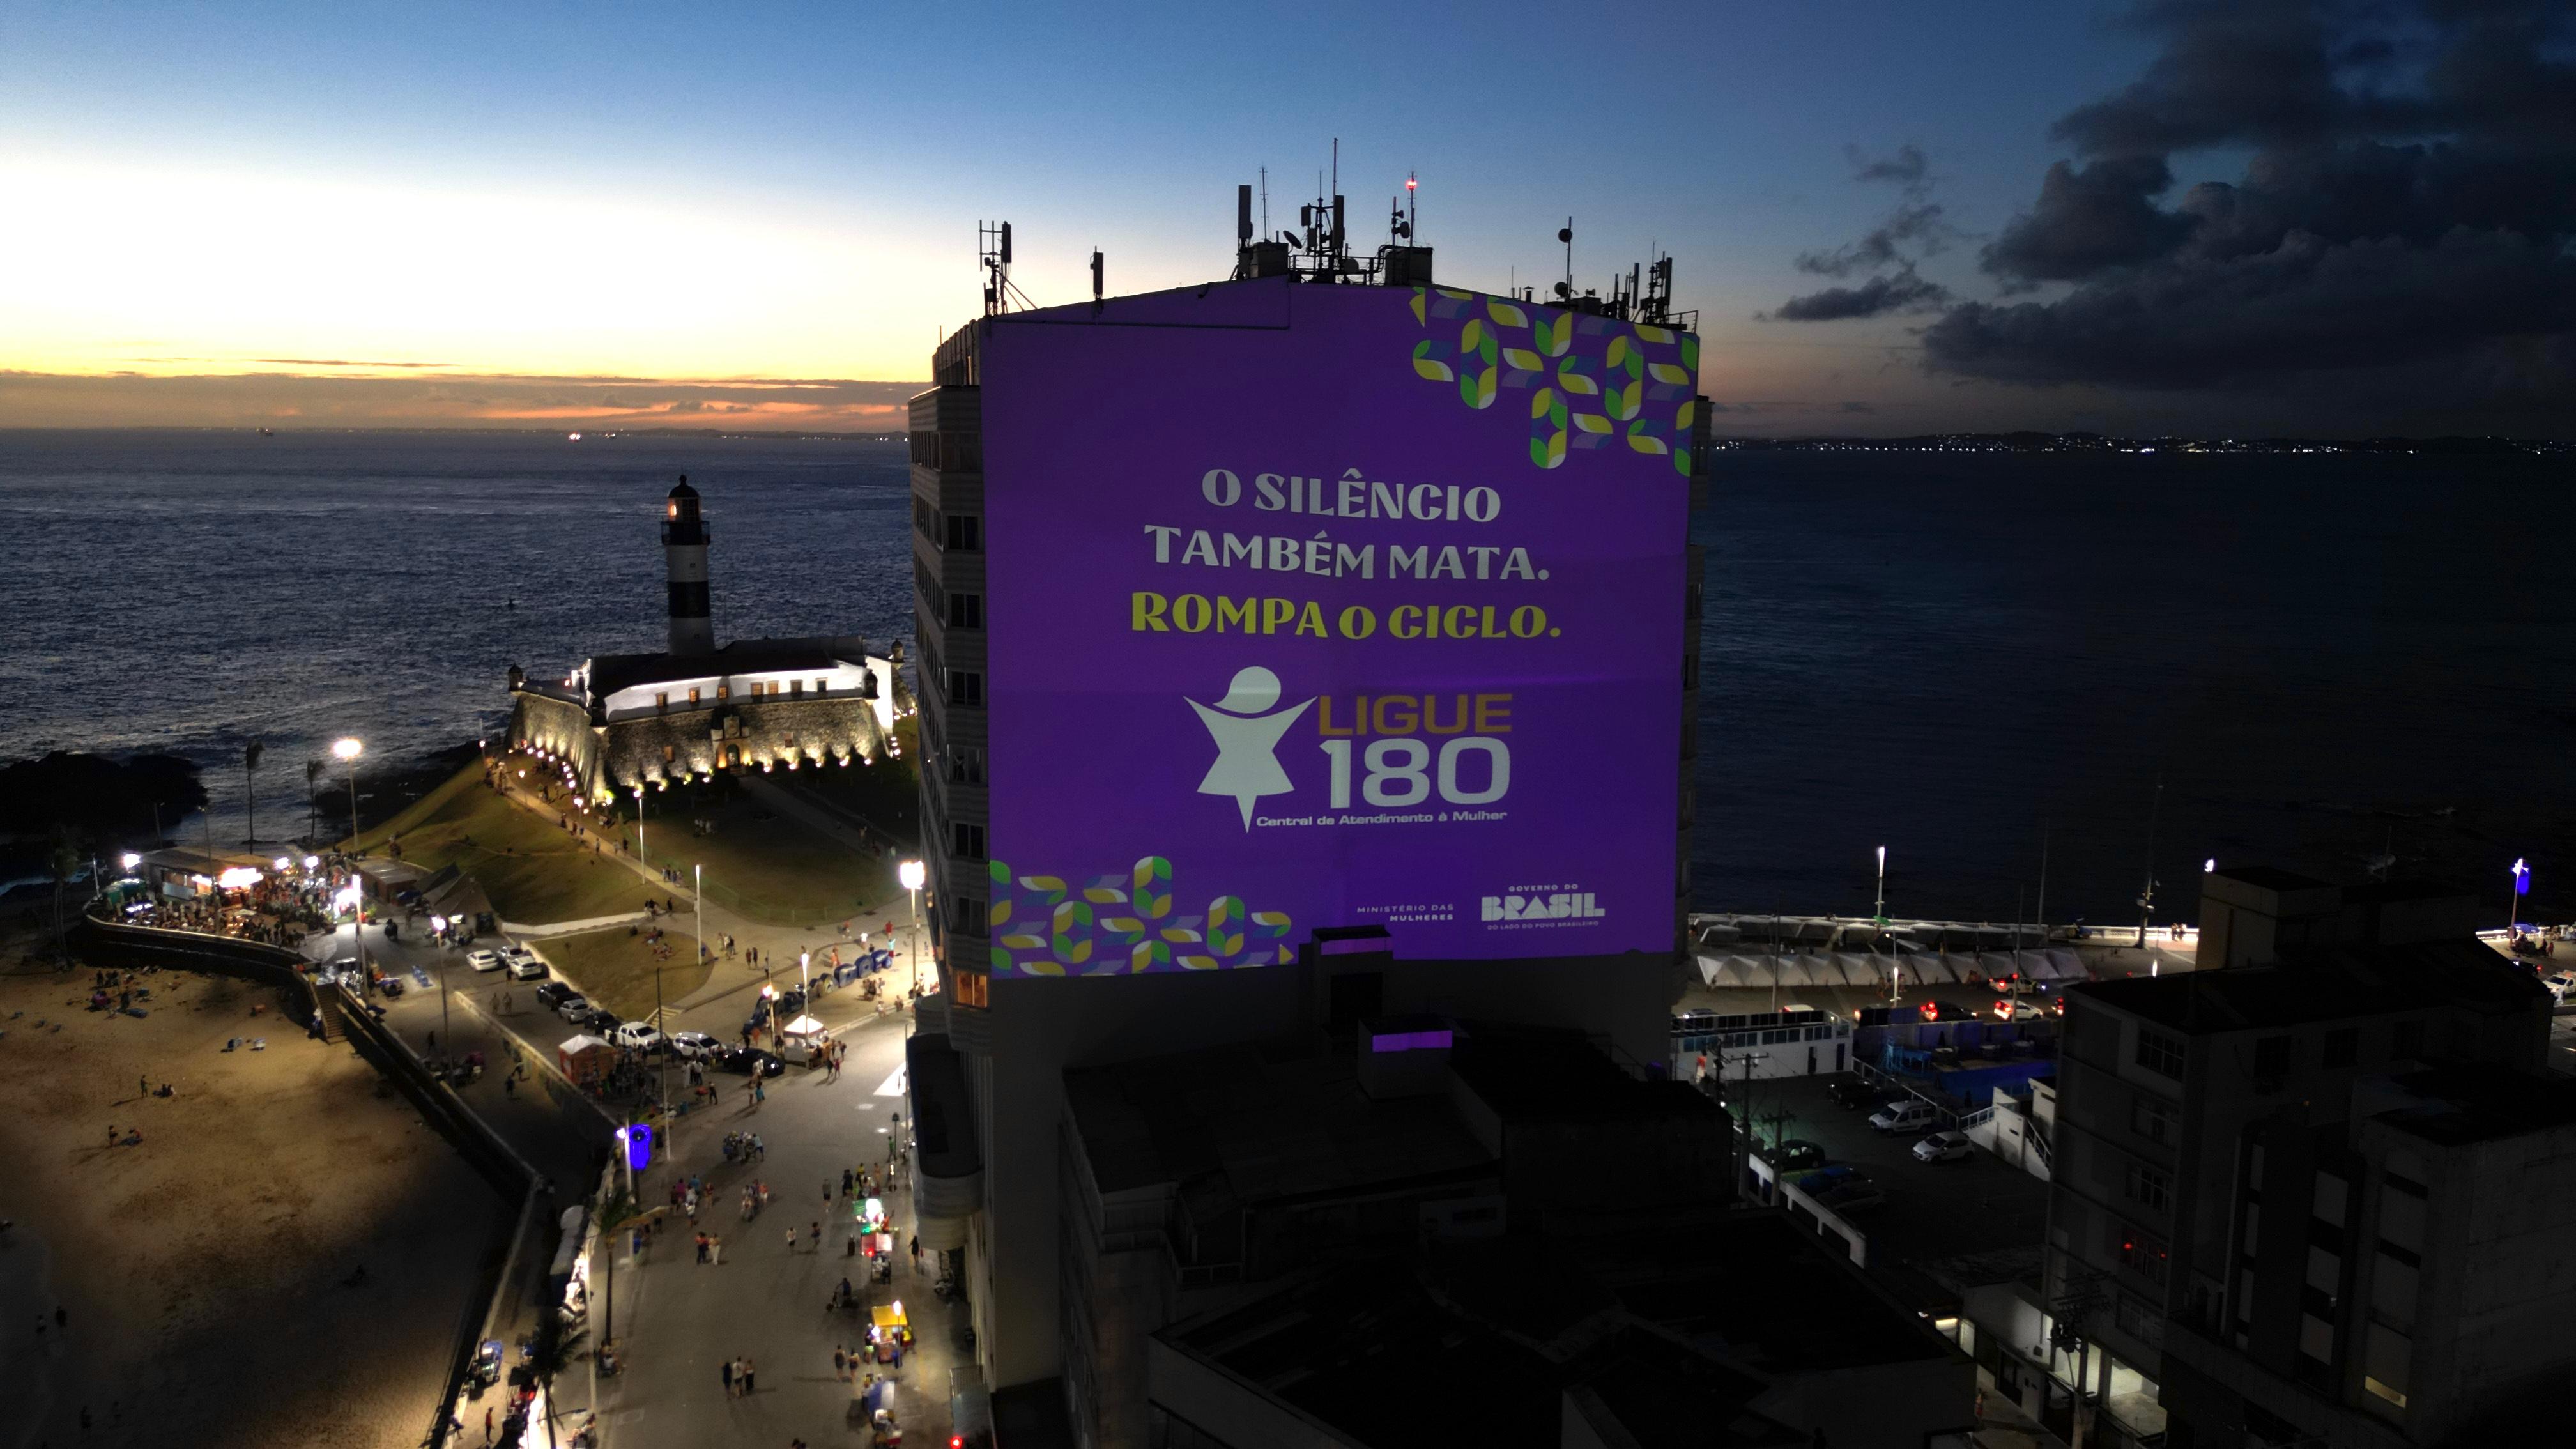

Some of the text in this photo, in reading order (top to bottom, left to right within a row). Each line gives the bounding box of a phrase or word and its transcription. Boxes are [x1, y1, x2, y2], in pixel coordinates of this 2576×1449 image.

[1202, 468, 1501, 523] O SILÊNCIO
[1144, 525, 1549, 581] TAMBÉM MATA.
[1132, 592, 1561, 640] ROMPA O CICLO.
[1319, 694, 1512, 735] LIGUE
[1319, 736, 1510, 809] 180
[1256, 810, 1508, 827] Central de Atendimento à Mulher
[1357, 903, 1427, 913] MINISTÉRIO
[1481, 893, 1606, 921] BRASIL
